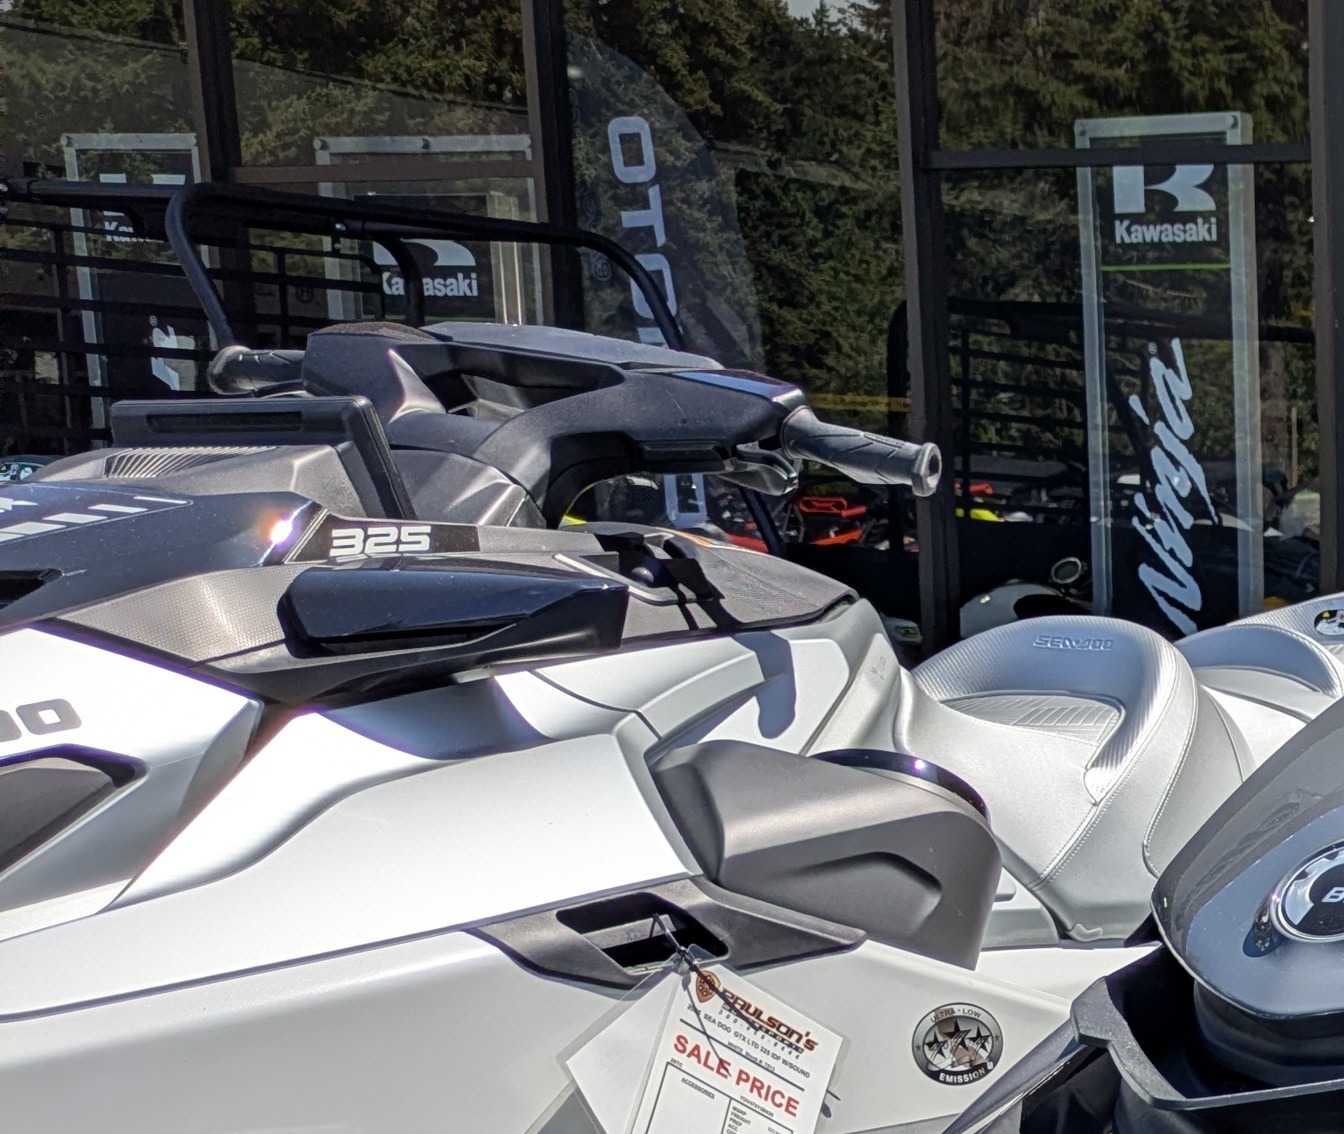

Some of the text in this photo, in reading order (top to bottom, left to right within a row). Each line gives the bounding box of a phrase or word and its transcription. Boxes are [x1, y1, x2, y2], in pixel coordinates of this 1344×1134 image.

[1114, 217, 1218, 244] Kawasaki
[382, 271, 479, 297] Kaasaki
[1129, 337, 1220, 635] Ninja
[329, 525, 432, 556] 325
[930, 1007, 982, 1023] ULTRA LOW
[703, 1013, 719, 1027] SEA
[718, 1021, 732, 1034] DOO
[733, 1031, 747, 1043] GTX
[747, 1037, 760, 1050] LTD
[673, 1034, 800, 1118] SALE PRICE
[938, 1067, 986, 1083] EMISSION
